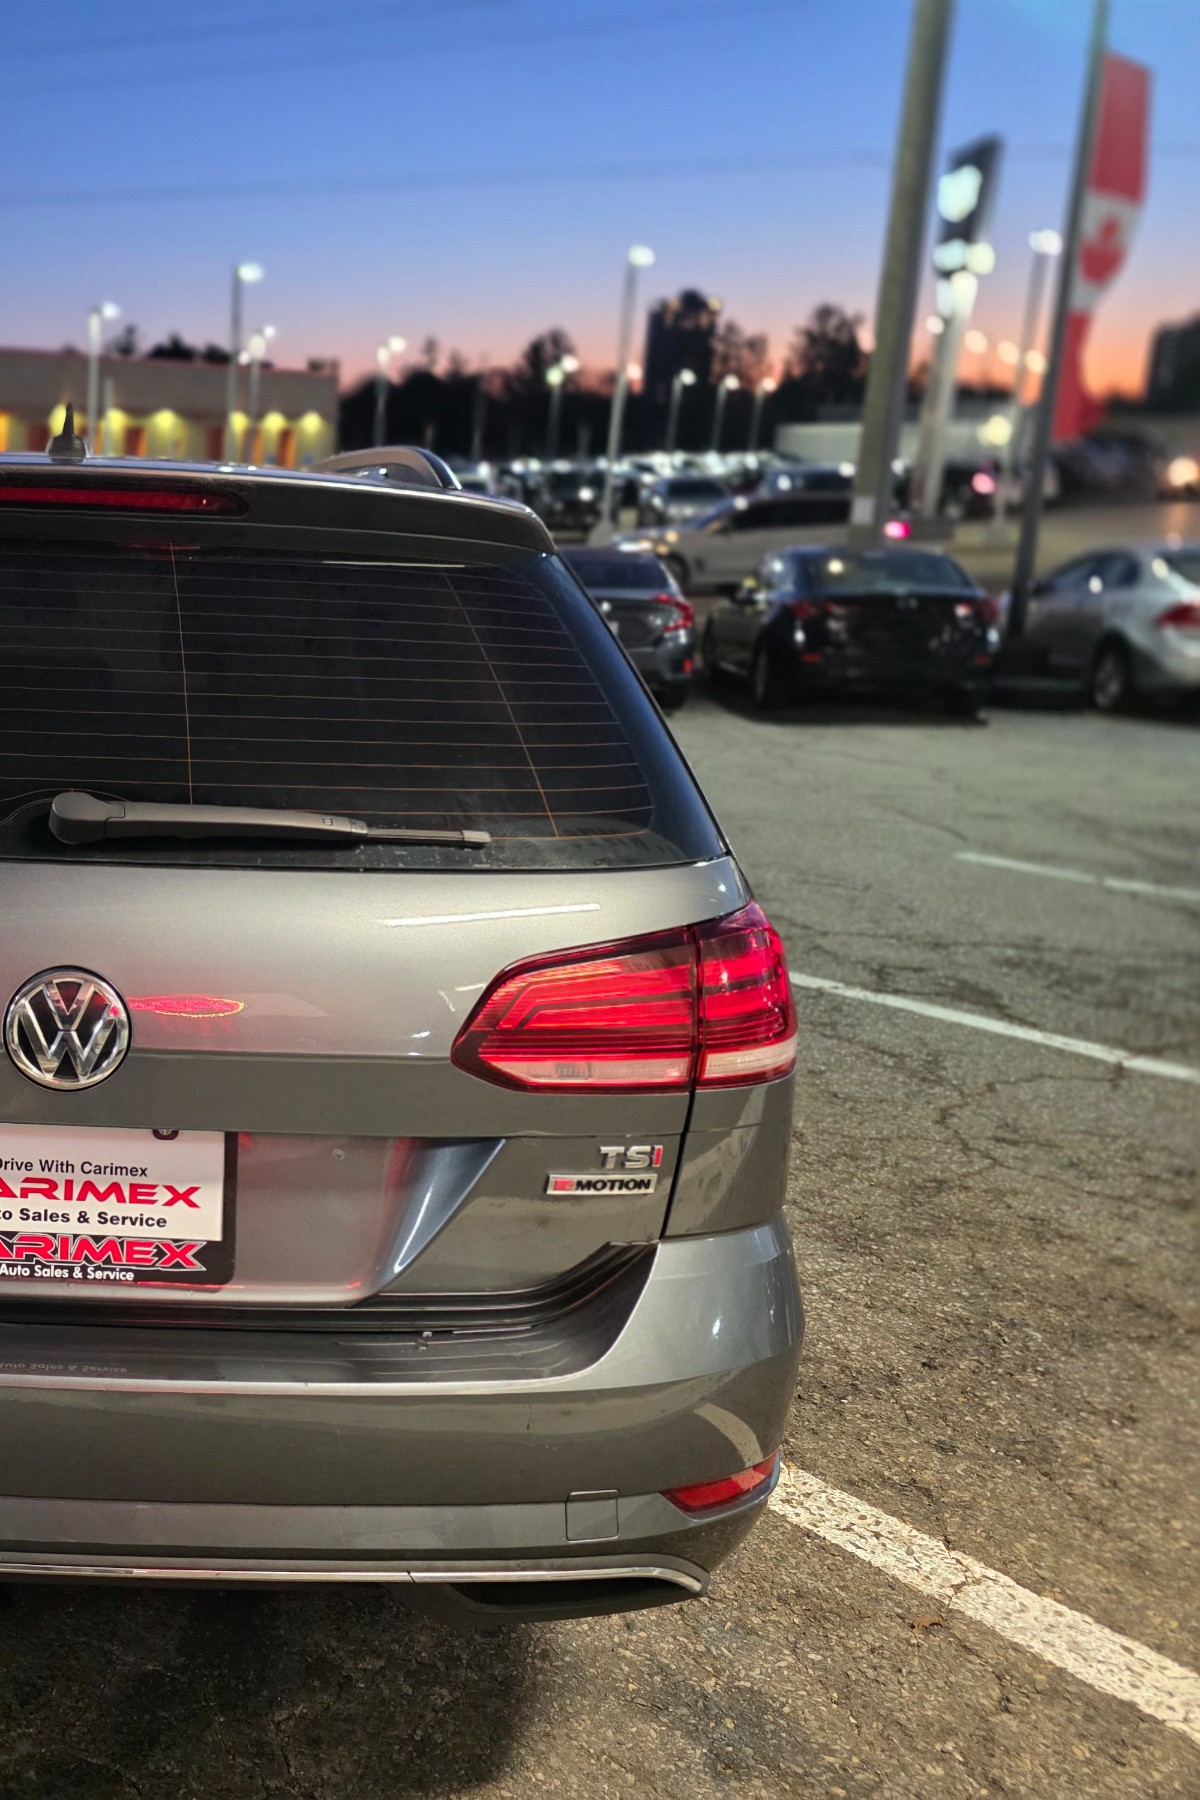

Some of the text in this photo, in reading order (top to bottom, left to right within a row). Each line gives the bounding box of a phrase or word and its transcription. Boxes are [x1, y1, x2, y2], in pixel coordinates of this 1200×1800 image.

[600, 1145, 664, 1170] TSI
[38, 1159, 75, 1175] With
[80, 1161, 149, 1178] Carimex
[19, 1207, 71, 1224] Sales
[77, 1210, 91, 1225] &
[97, 1211, 168, 1229] Service
[34, 1264, 69, 1280] Sales
[73, 1266, 84, 1280] &
[86, 1265, 135, 1283] Service
